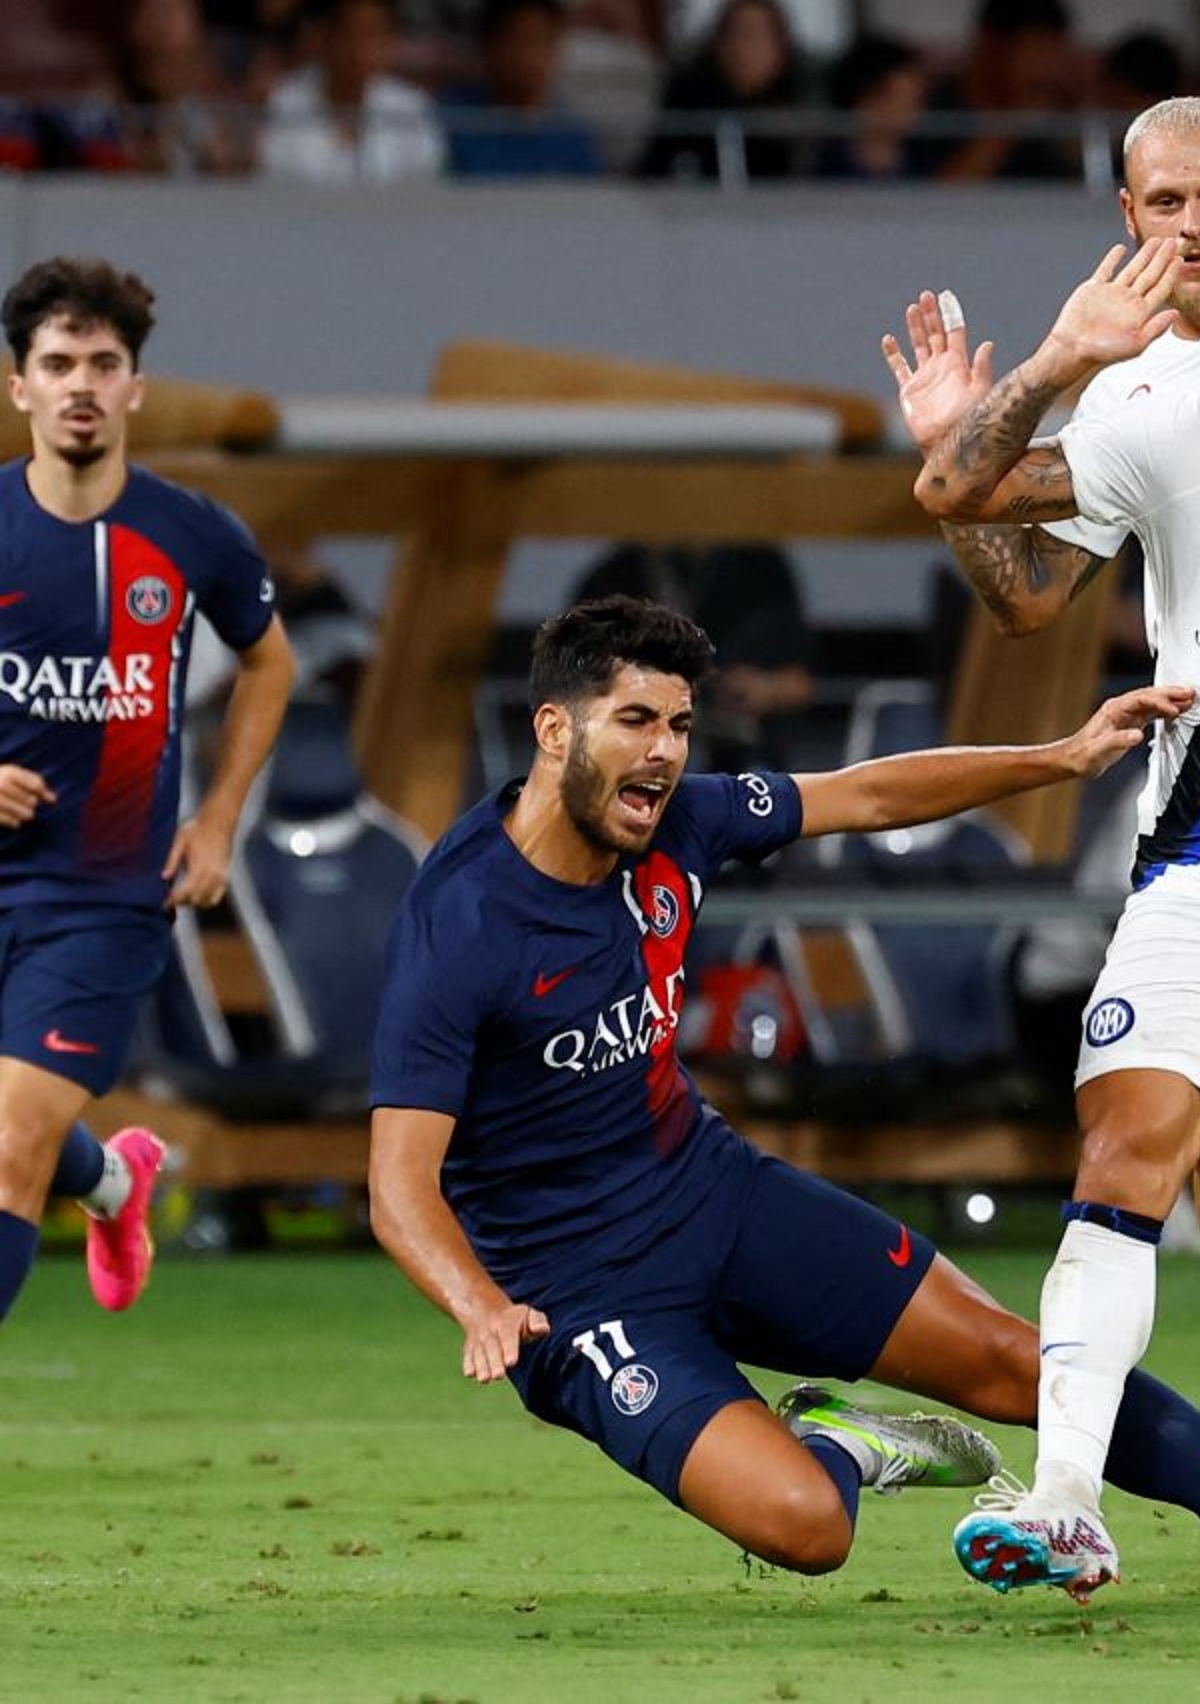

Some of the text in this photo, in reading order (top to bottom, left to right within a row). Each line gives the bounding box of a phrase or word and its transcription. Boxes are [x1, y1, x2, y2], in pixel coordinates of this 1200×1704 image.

[0, 652, 155, 704] QATAR
[29, 695, 154, 723] AIRWAYS
[571, 1319, 637, 1382] 11
